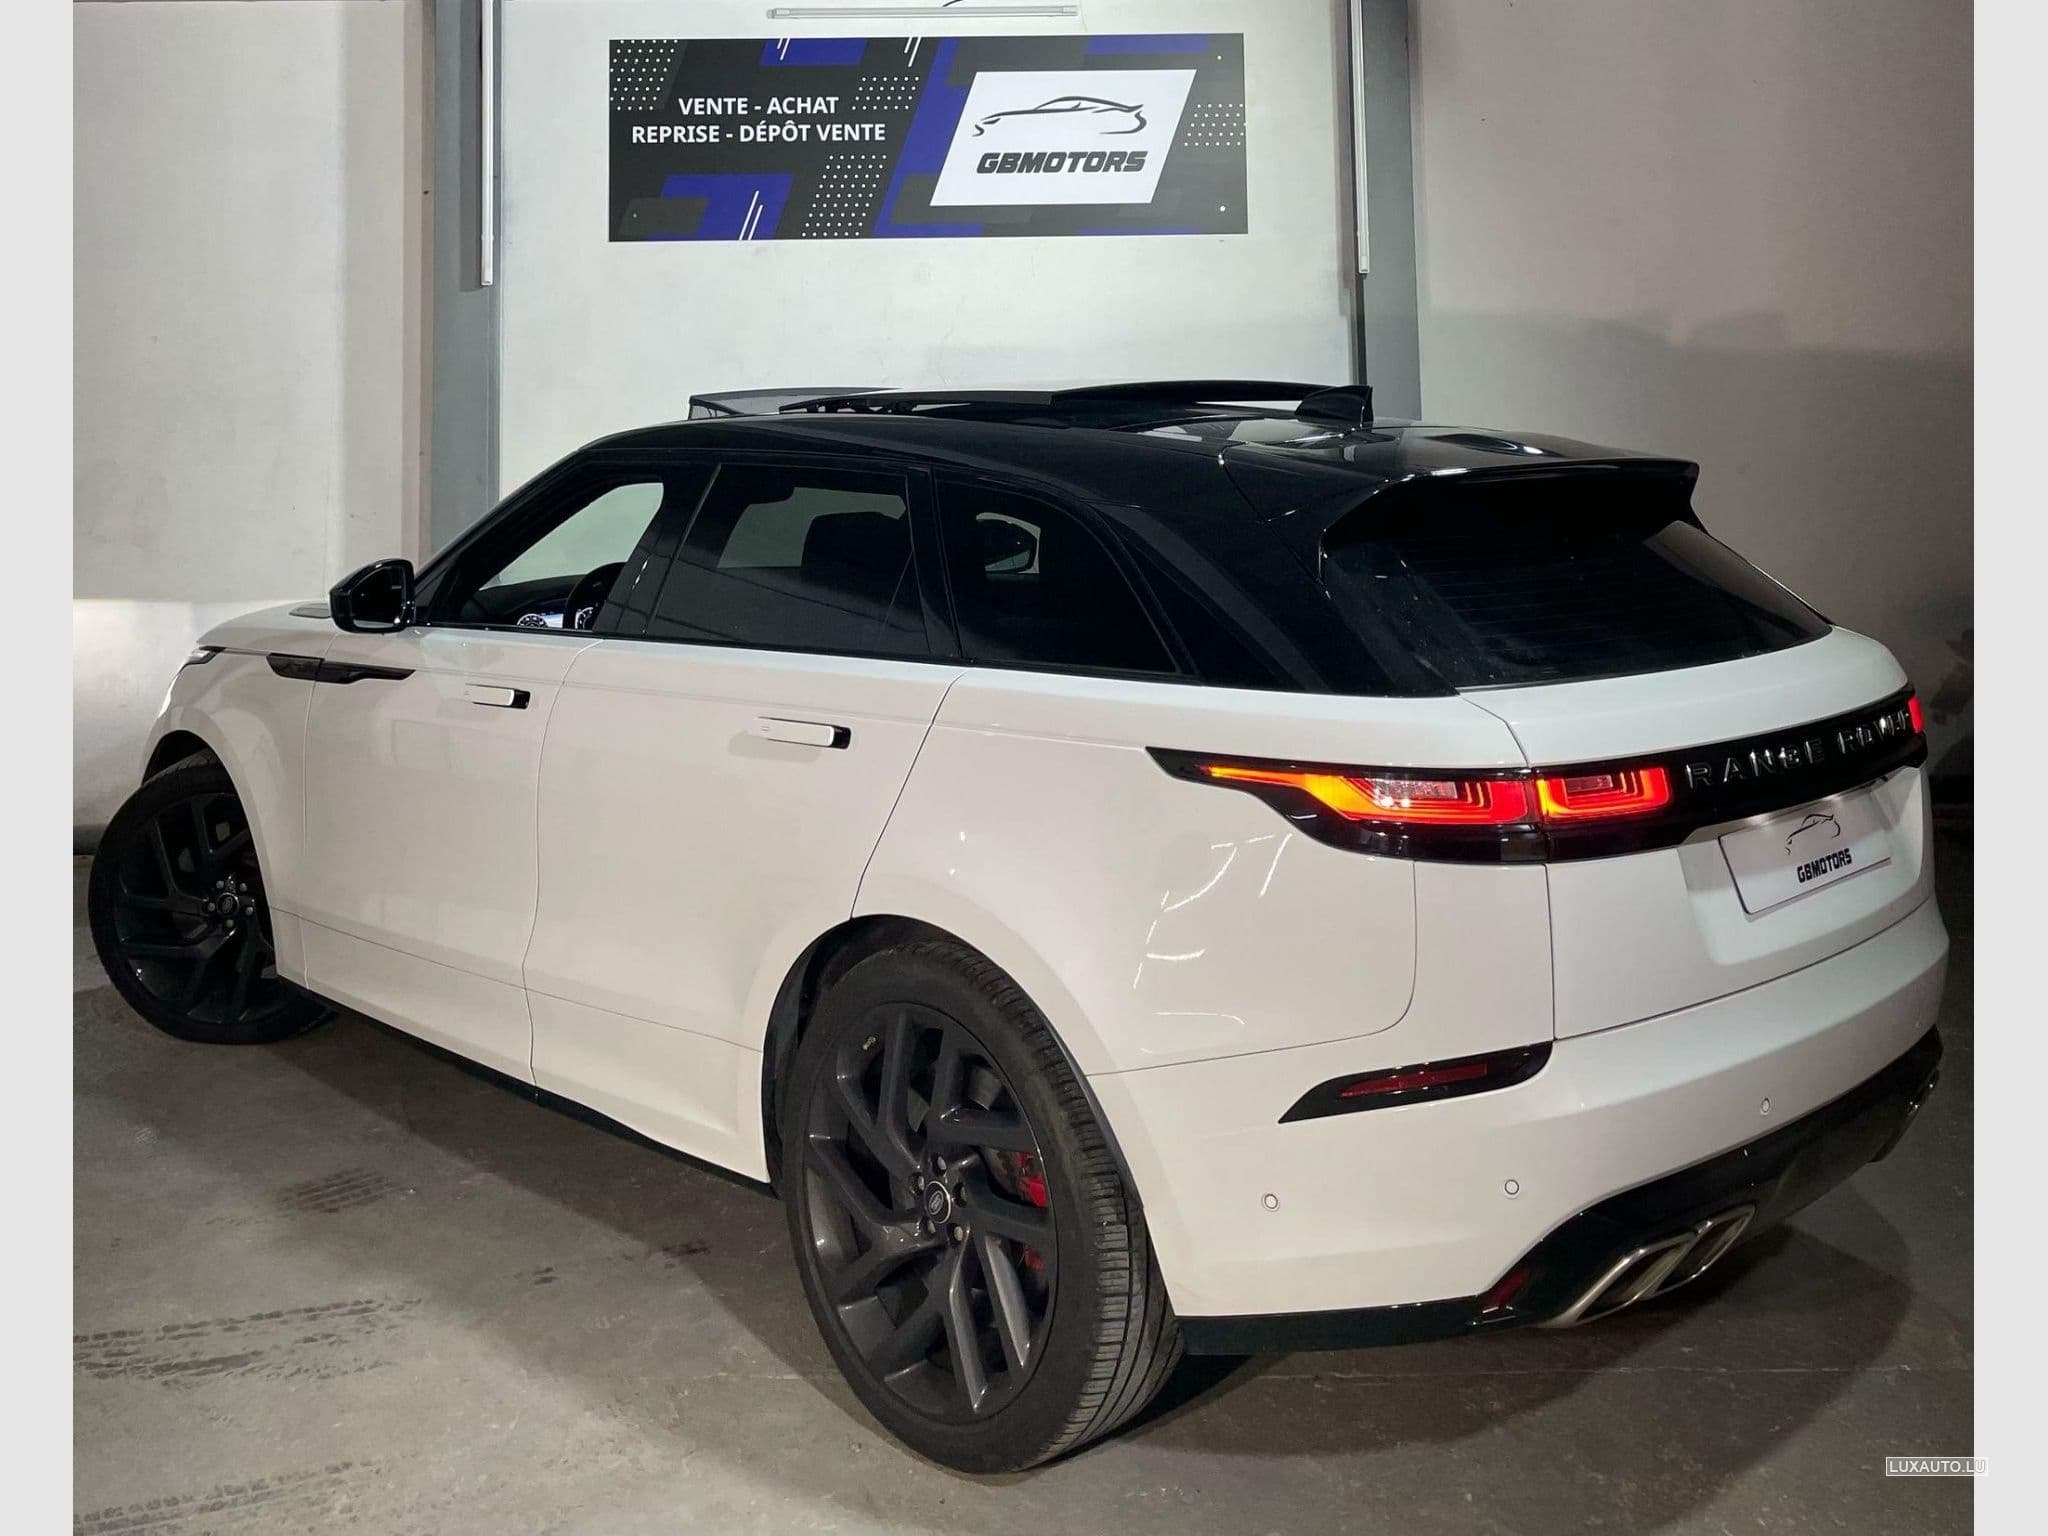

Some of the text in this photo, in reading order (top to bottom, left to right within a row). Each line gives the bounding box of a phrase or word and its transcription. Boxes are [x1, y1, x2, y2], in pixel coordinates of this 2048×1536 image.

[678, 98, 748, 115] VENTE
[767, 97, 839, 114] ACHAT
[632, 125, 720, 144] REPRISE
[739, 120, 810, 142] DÉPÔT
[816, 123, 886, 141] VENTE
[976, 150, 1148, 174] GBMOTORS
[1685, 737, 1823, 790] RANGE
[1797, 848, 1852, 883] GBMOTORS
